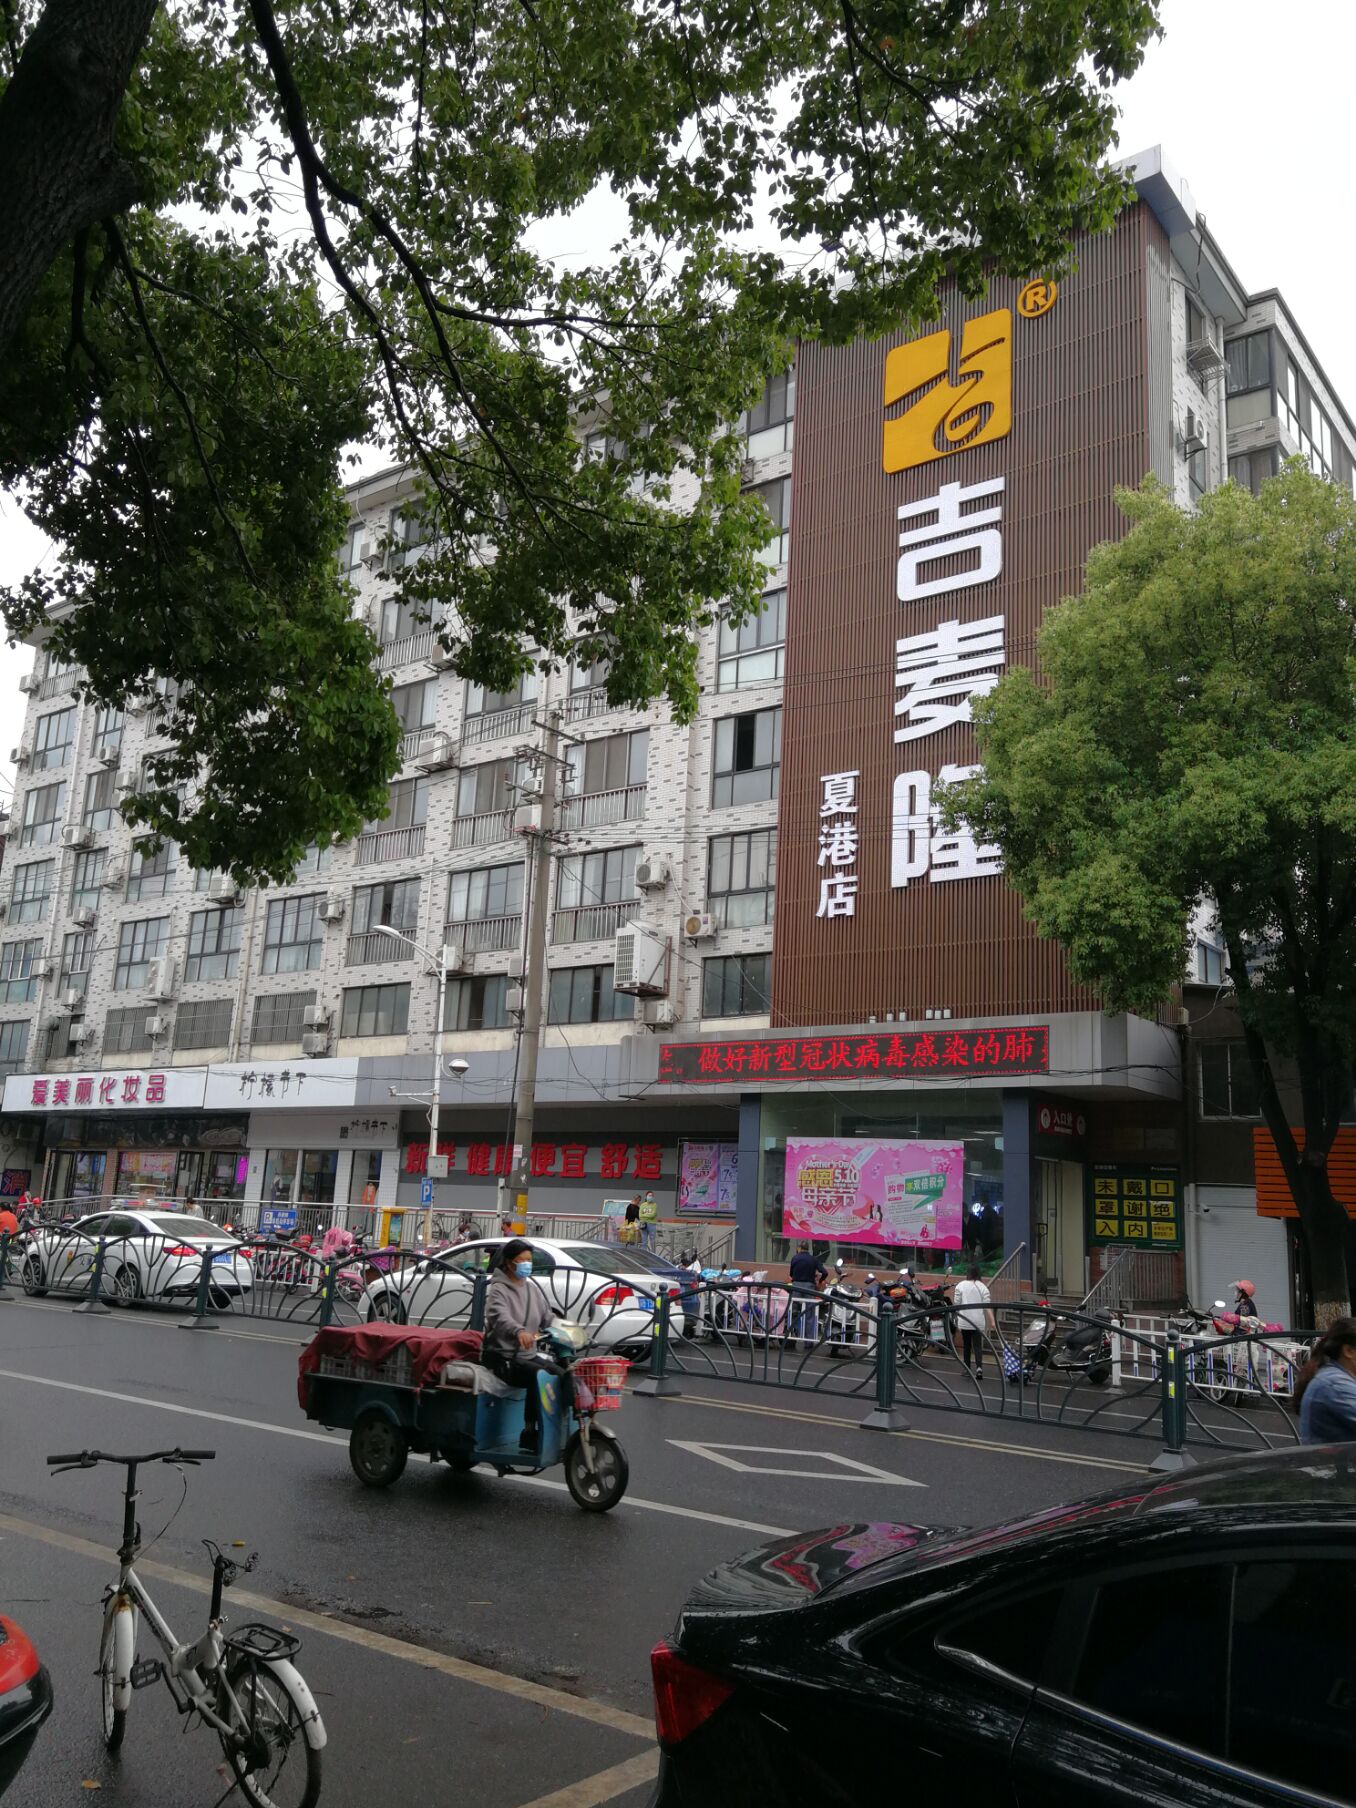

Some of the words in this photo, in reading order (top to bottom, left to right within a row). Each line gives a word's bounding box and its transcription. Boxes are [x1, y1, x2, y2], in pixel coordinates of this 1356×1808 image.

[891, 476, 1006, 889] 吉麦隆
[816, 769, 860, 920] 夏港店
[698, 1032, 1046, 1074] 做好新型冠状病毒感染的肺
[31, 1074, 166, 1106] 爱美丽化妆品
[529, 1143, 588, 1178] 便宜
[600, 1143, 664, 1180] 舒适
[797, 1169, 834, 1187] 感恩
[423, 1185, 431, 1201] P
[801, 1187, 858, 1207] 母亲节
